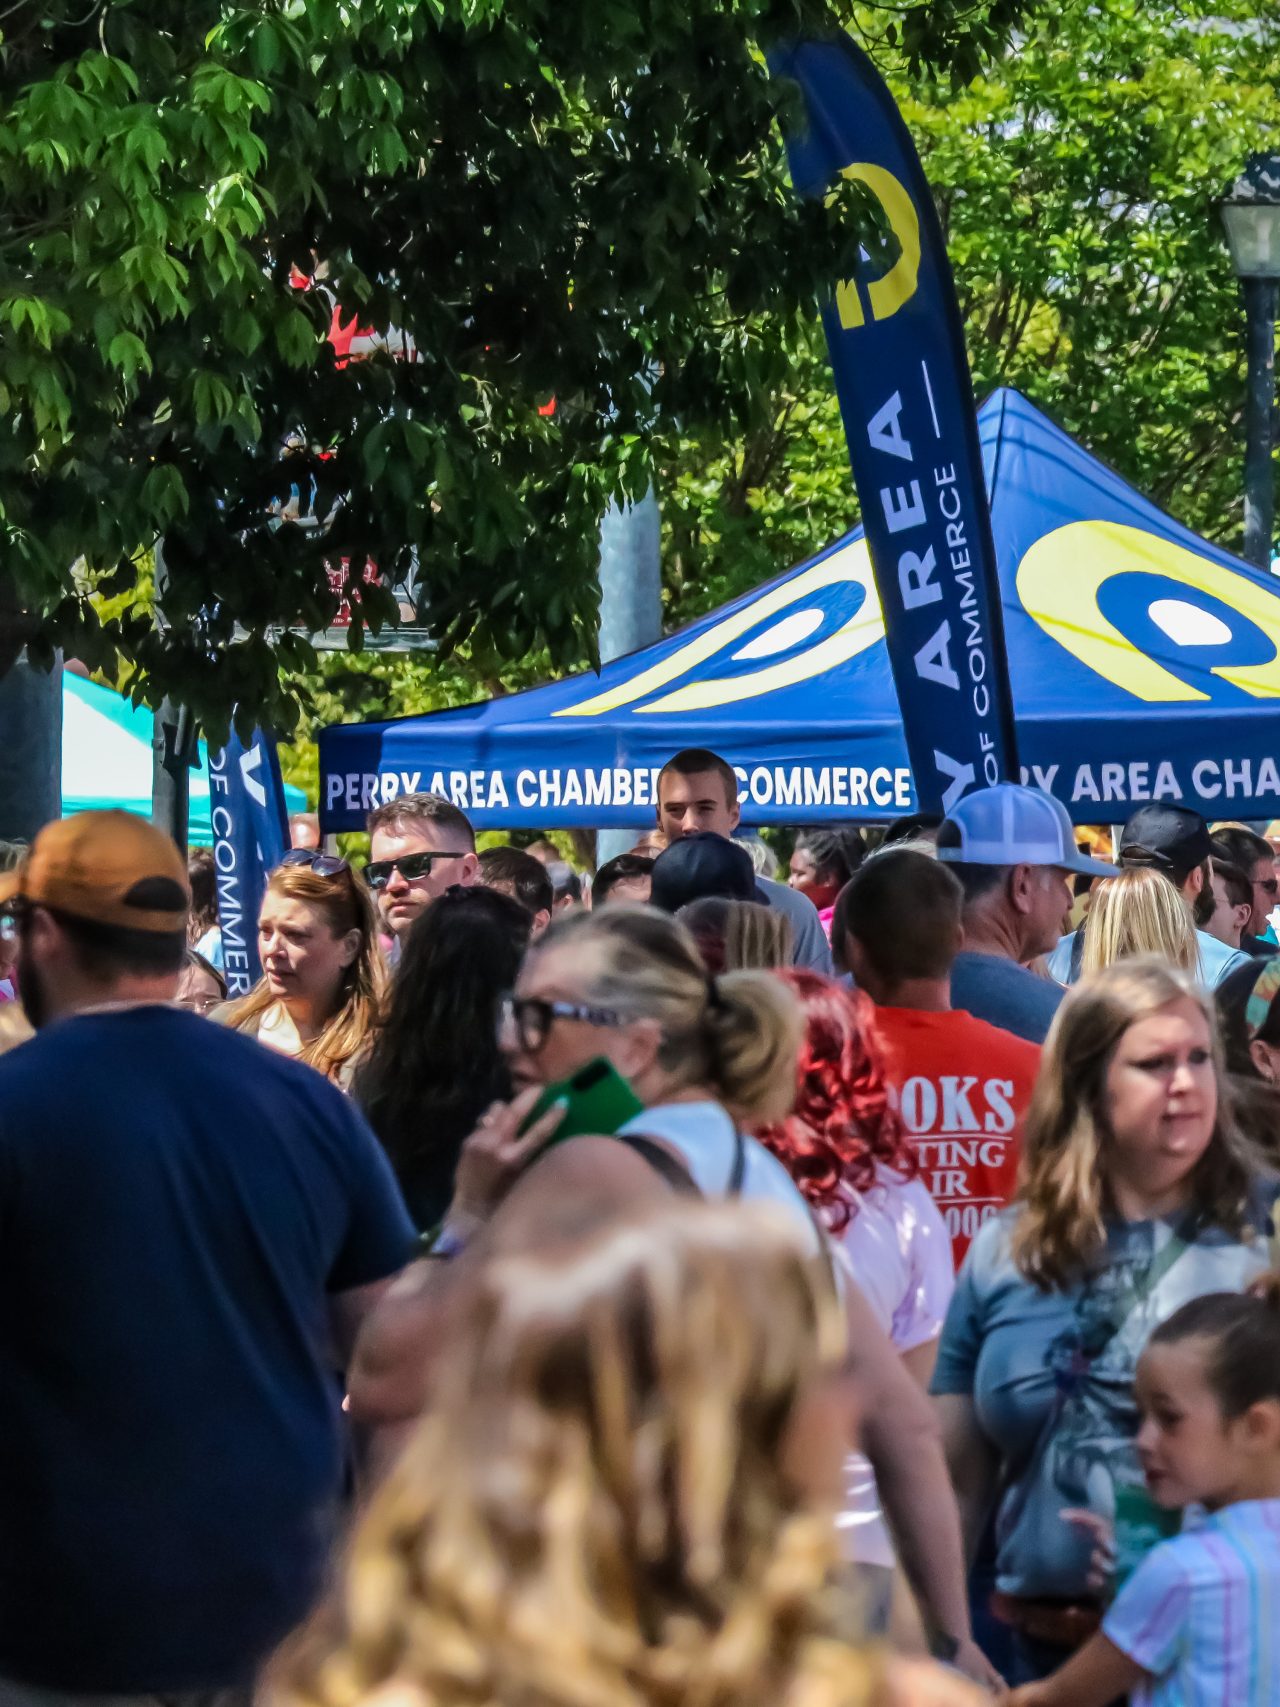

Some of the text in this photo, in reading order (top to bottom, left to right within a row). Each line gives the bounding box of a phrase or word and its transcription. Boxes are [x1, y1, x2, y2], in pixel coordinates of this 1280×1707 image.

[867, 390, 960, 691] AREA
[933, 462, 999, 788] OF COMMERCE
[326, 771, 421, 811] PERRY
[430, 769, 510, 809] AREA
[1070, 761, 1183, 802] AREA
